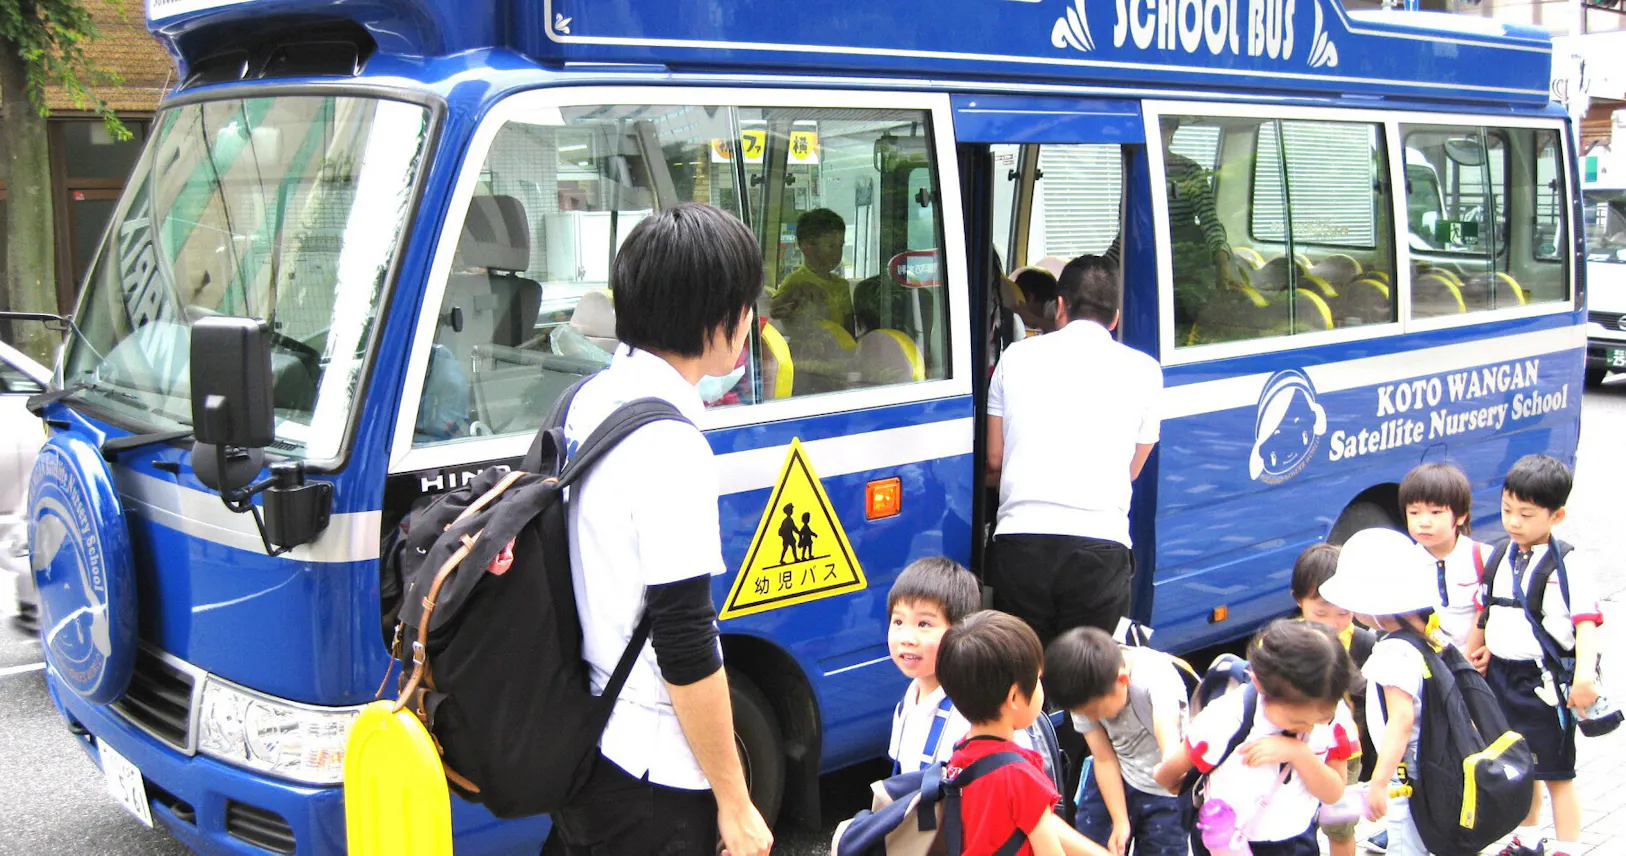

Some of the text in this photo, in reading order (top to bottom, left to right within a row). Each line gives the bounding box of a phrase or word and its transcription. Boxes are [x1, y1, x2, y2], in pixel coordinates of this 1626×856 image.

[1113, 0, 1296, 61] SCHOOL BUS
[1376, 359, 1540, 418] KOTO WANGAN
[1328, 417, 1424, 462] Satellite
[1428, 403, 1509, 440] Nursery
[1511, 383, 1569, 420] School
[66, 473, 91, 534] Nursery
[86, 535, 104, 593] School
[754, 562, 838, 595] 幼児バス
